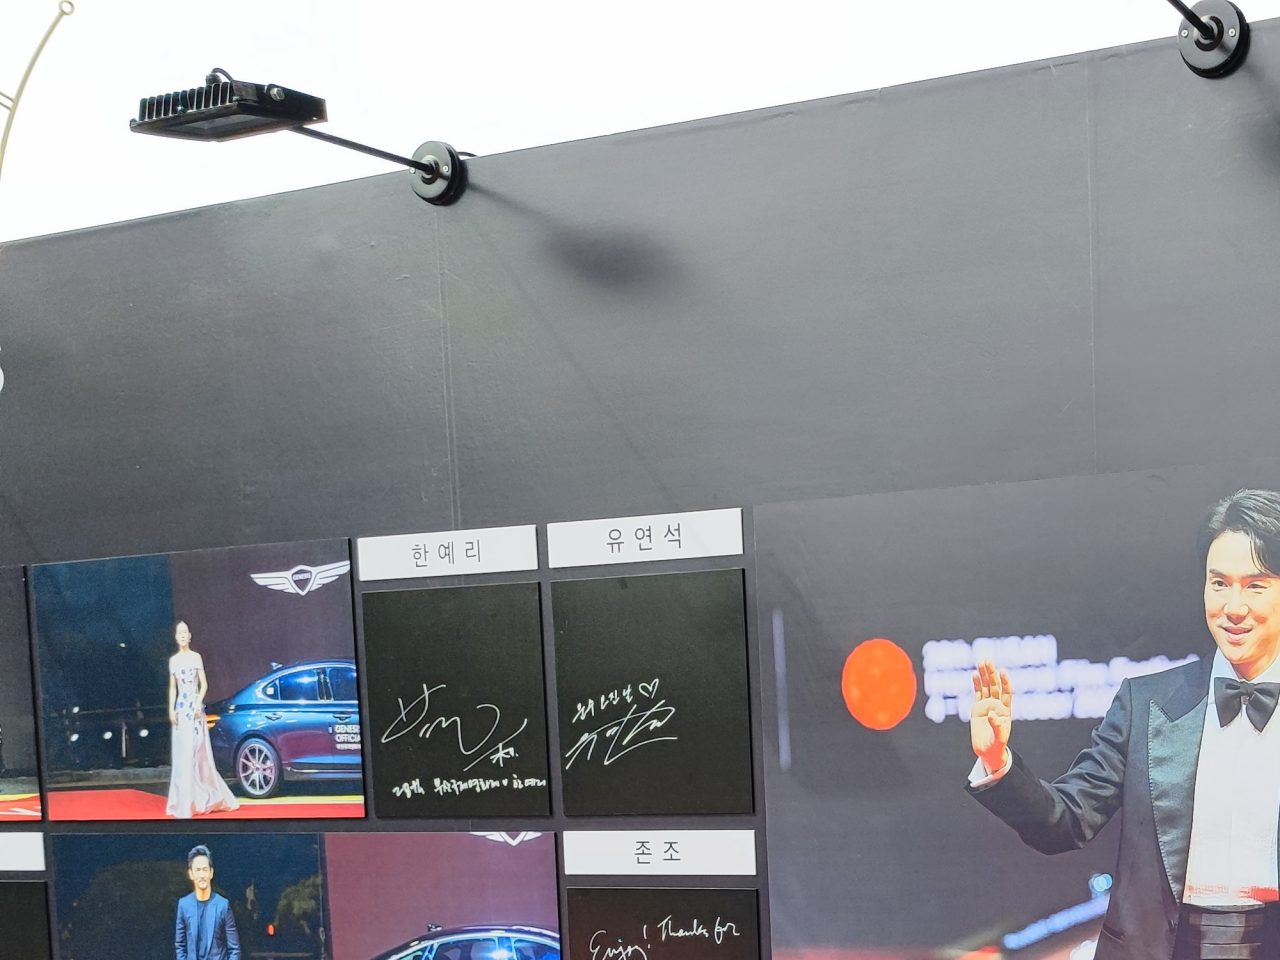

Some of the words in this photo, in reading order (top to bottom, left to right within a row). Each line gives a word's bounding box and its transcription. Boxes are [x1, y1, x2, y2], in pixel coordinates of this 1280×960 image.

[410, 538, 482, 569] 한예리
[605, 522, 682, 554] 유연석
[657, 914, 709, 943] Thanks
[713, 916, 741, 945] for
